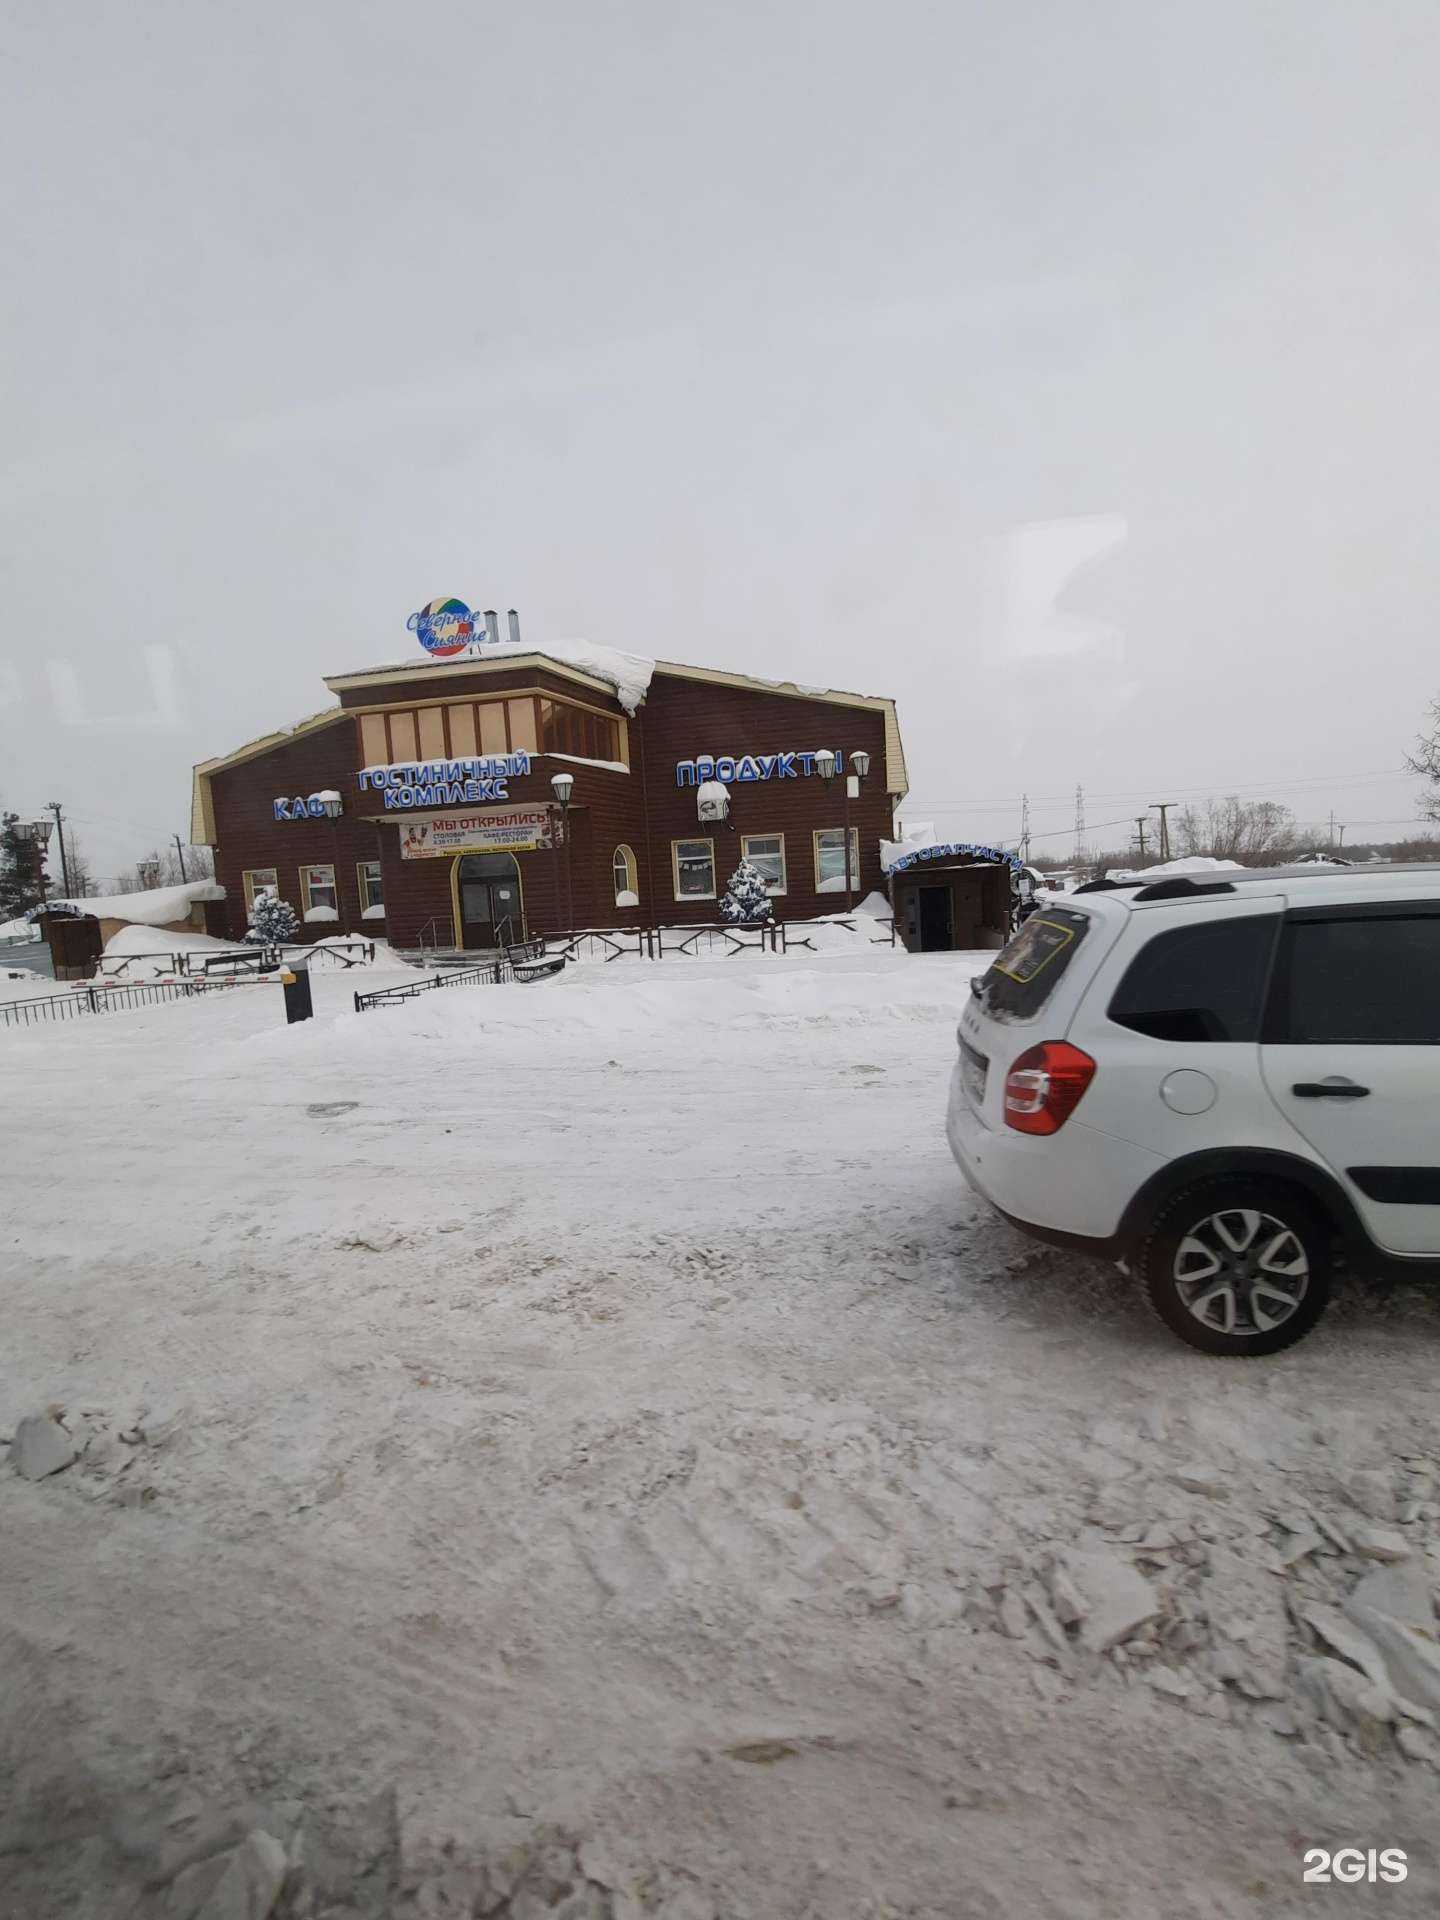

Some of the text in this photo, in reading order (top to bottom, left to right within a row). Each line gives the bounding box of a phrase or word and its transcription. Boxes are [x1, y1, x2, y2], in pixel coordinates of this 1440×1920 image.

[406, 610, 481, 631] Северное
[423, 629, 487, 649] Сияние
[358, 749, 531, 791] ГОСТИНИЧНЫЙ
[272, 793, 343, 820] КАФ
[384, 778, 509, 809] КОМПЛЕКС
[432, 819, 457, 831] МЫ
[888, 843, 1024, 875] АВТОЗАПЧАСТИ
